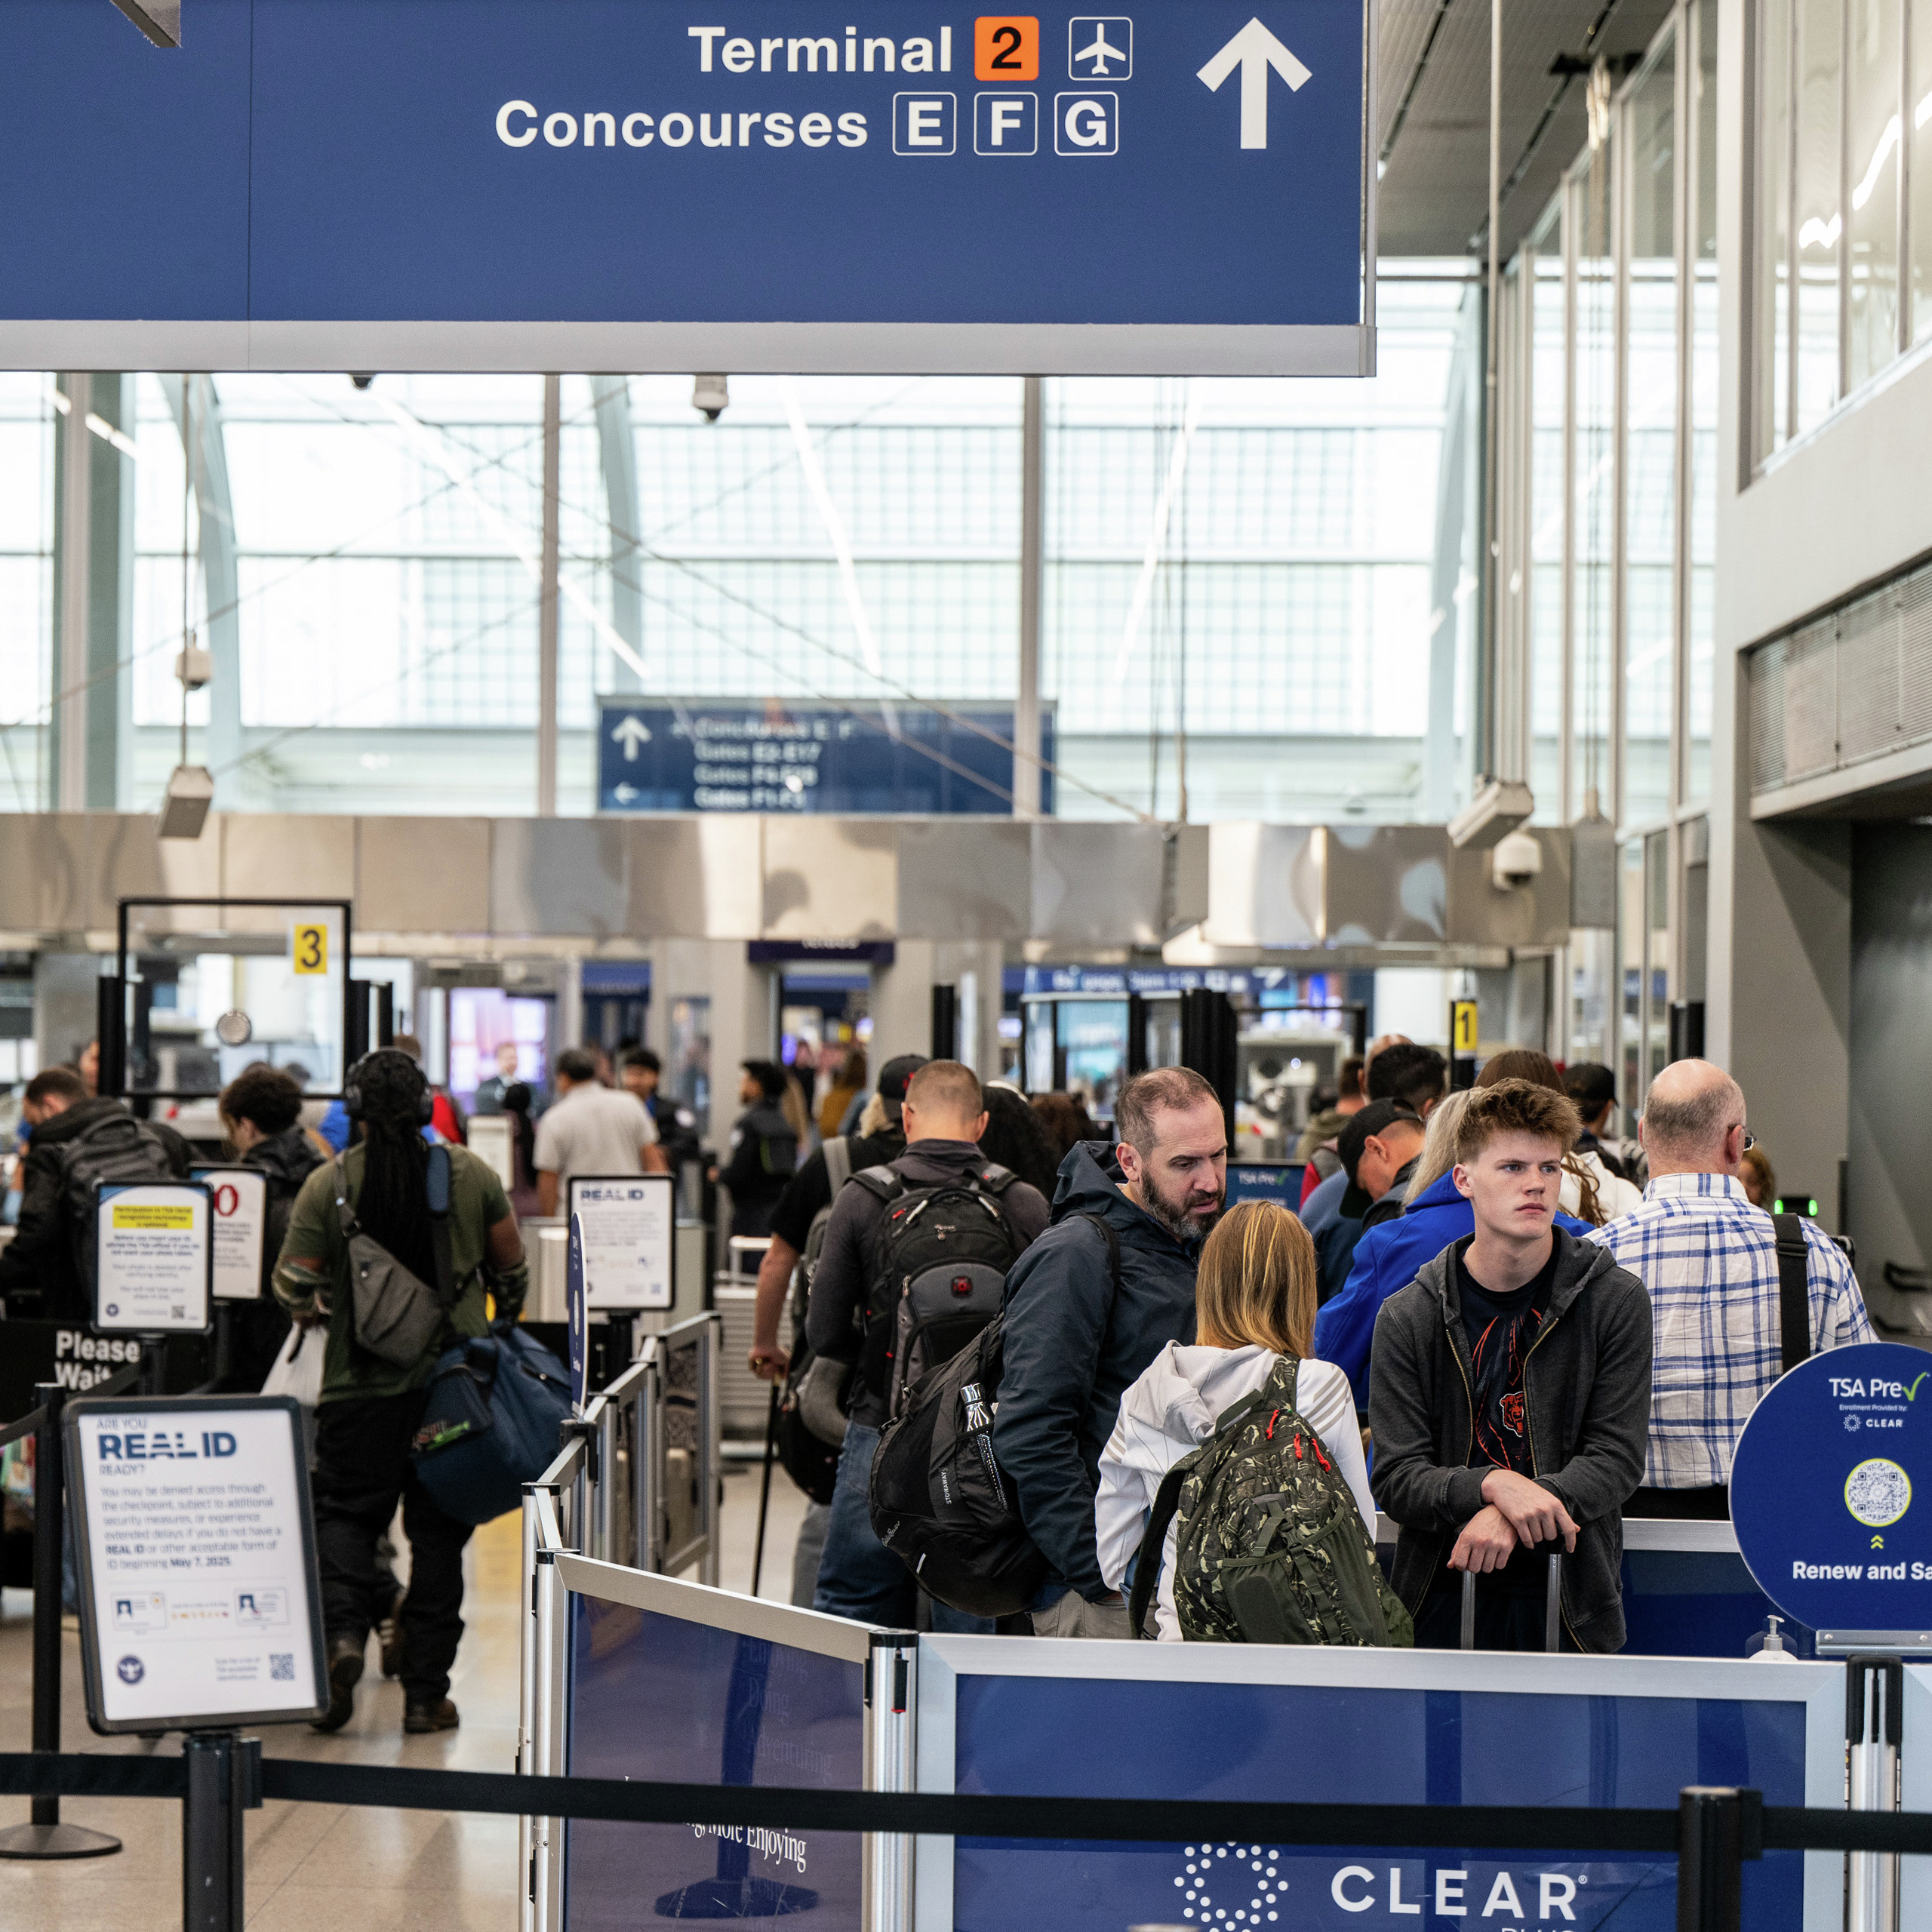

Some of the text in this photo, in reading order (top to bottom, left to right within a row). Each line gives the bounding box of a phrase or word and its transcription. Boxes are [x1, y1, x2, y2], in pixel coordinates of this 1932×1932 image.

[688, 26, 1022, 72] Terminal 2
[495, 100, 1106, 148] Concourses E F G
[300, 928, 321, 970] 3
[1461, 1011, 1469, 1044] 1
[581, 1189, 644, 1201] REAL ID
[56, 1330, 140, 1364] Please
[1829, 1378, 1866, 1398] TSA
[1898, 1404, 1908, 1413] by:
[97, 1417, 147, 1430] ARE YOU
[1866, 1418, 1903, 1428] CLEAR
[99, 1432, 237, 1460] REAL ID
[99, 1464, 145, 1476] READY?
[100, 1484, 266, 1498] You may be denied access through
[940, 1472, 952, 1504] STOWAWAY
[102, 1502, 116, 1511] the
[178, 1499, 212, 1510] subject
[215, 1499, 223, 1509] to
[228, 1497, 272, 1508] additional
[104, 1515, 141, 1526] security
[208, 1513, 260, 1524] experience
[104, 1530, 149, 1540] extended
[152, 1529, 183, 1540] delays
[196, 1530, 213, 1540] you
[216, 1527, 227, 1537] do
[231, 1528, 246, 1537] not
[249, 1526, 272, 1536] have
[106, 1545, 131, 1555] REAL
[134, 1545, 144, 1554] ID
[160, 1543, 186, 1553] other
[189, 1543, 238, 1553] acceptable
[242, 1541, 263, 1551] form
[266, 1540, 277, 1550] of
[107, 1560, 117, 1570] ID
[120, 1558, 168, 1571] beginning
[170, 1556, 190, 1568] May
[1792, 1561, 1863, 1580] Renew
[1866, 1561, 1906, 1580] and
[746, 1826, 807, 1873] Enjoying
[1331, 1865, 1577, 1921] CLEAR
